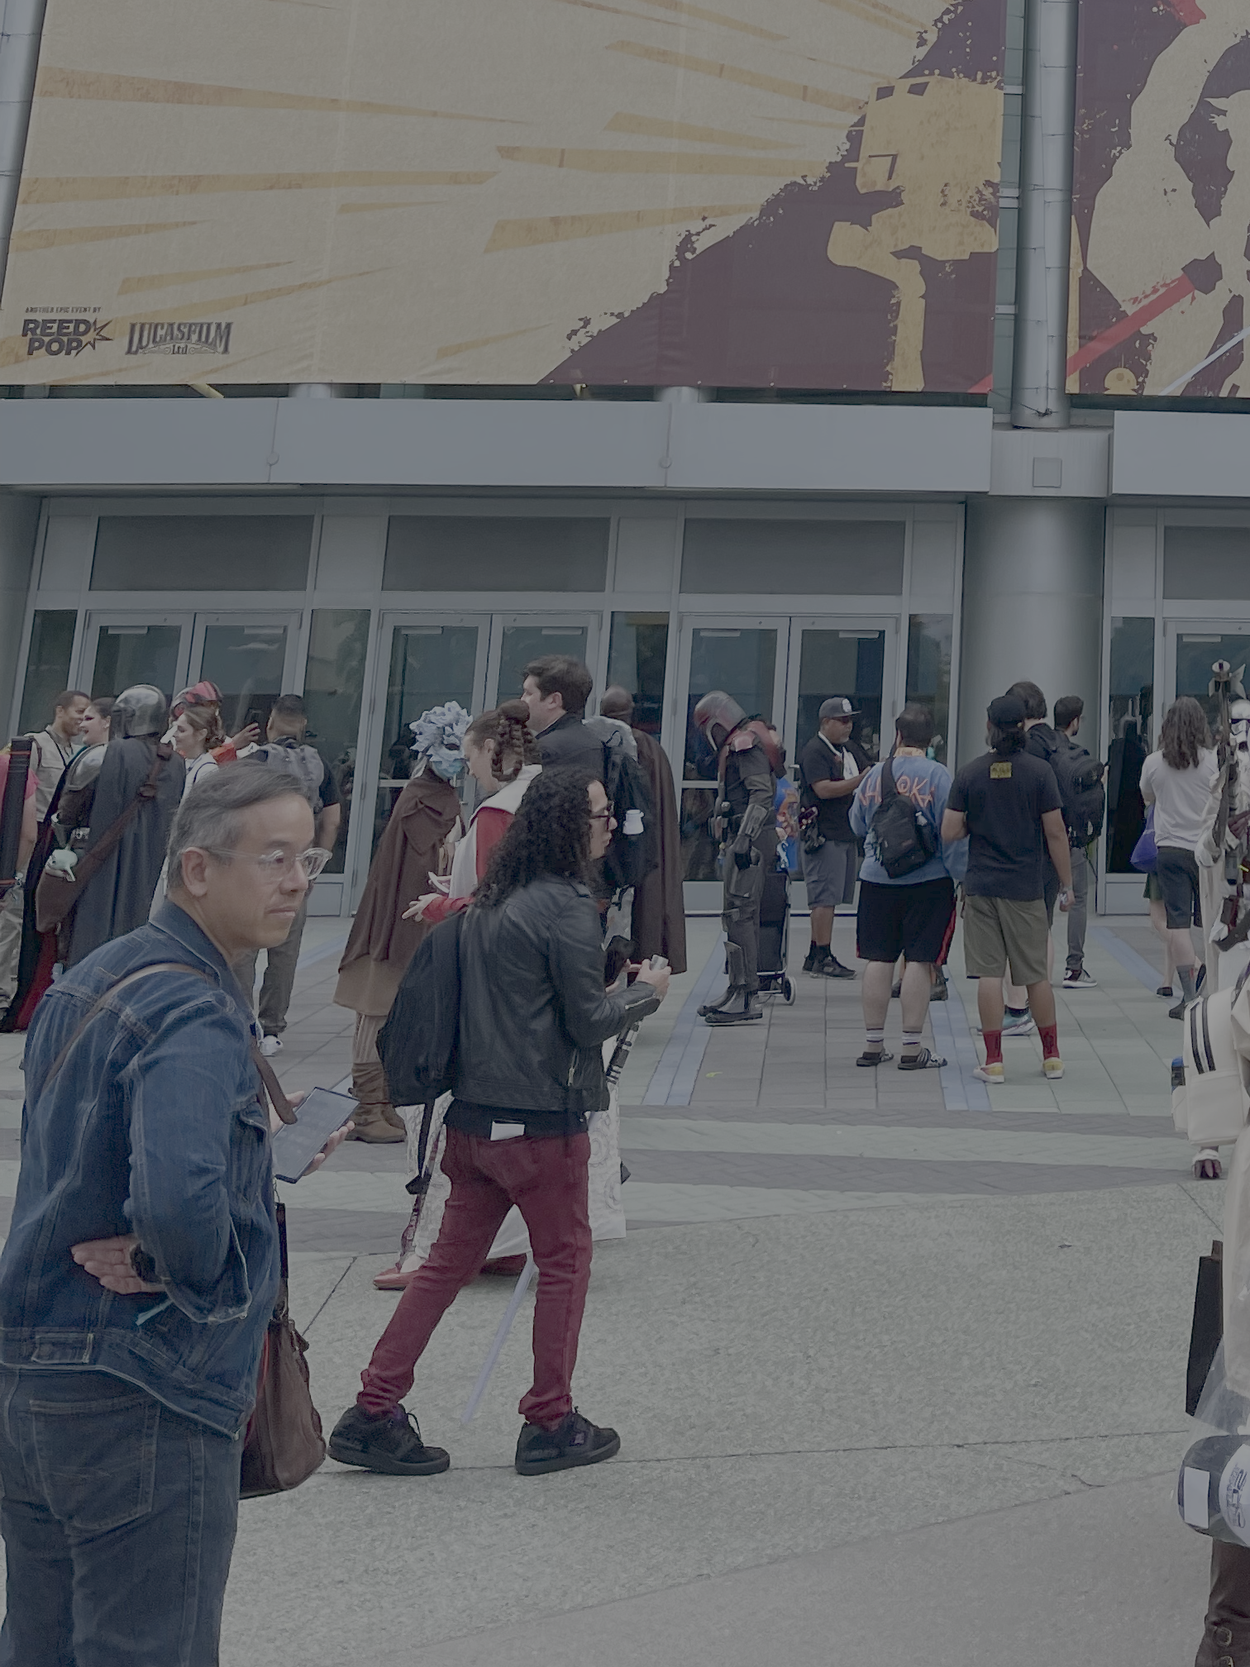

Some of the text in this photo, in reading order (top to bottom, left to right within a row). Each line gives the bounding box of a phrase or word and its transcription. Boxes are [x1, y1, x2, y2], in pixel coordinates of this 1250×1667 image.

[21, 318, 92, 337] REED
[27, 337, 83, 356] POP
[125, 321, 234, 355] LUCASFILM
